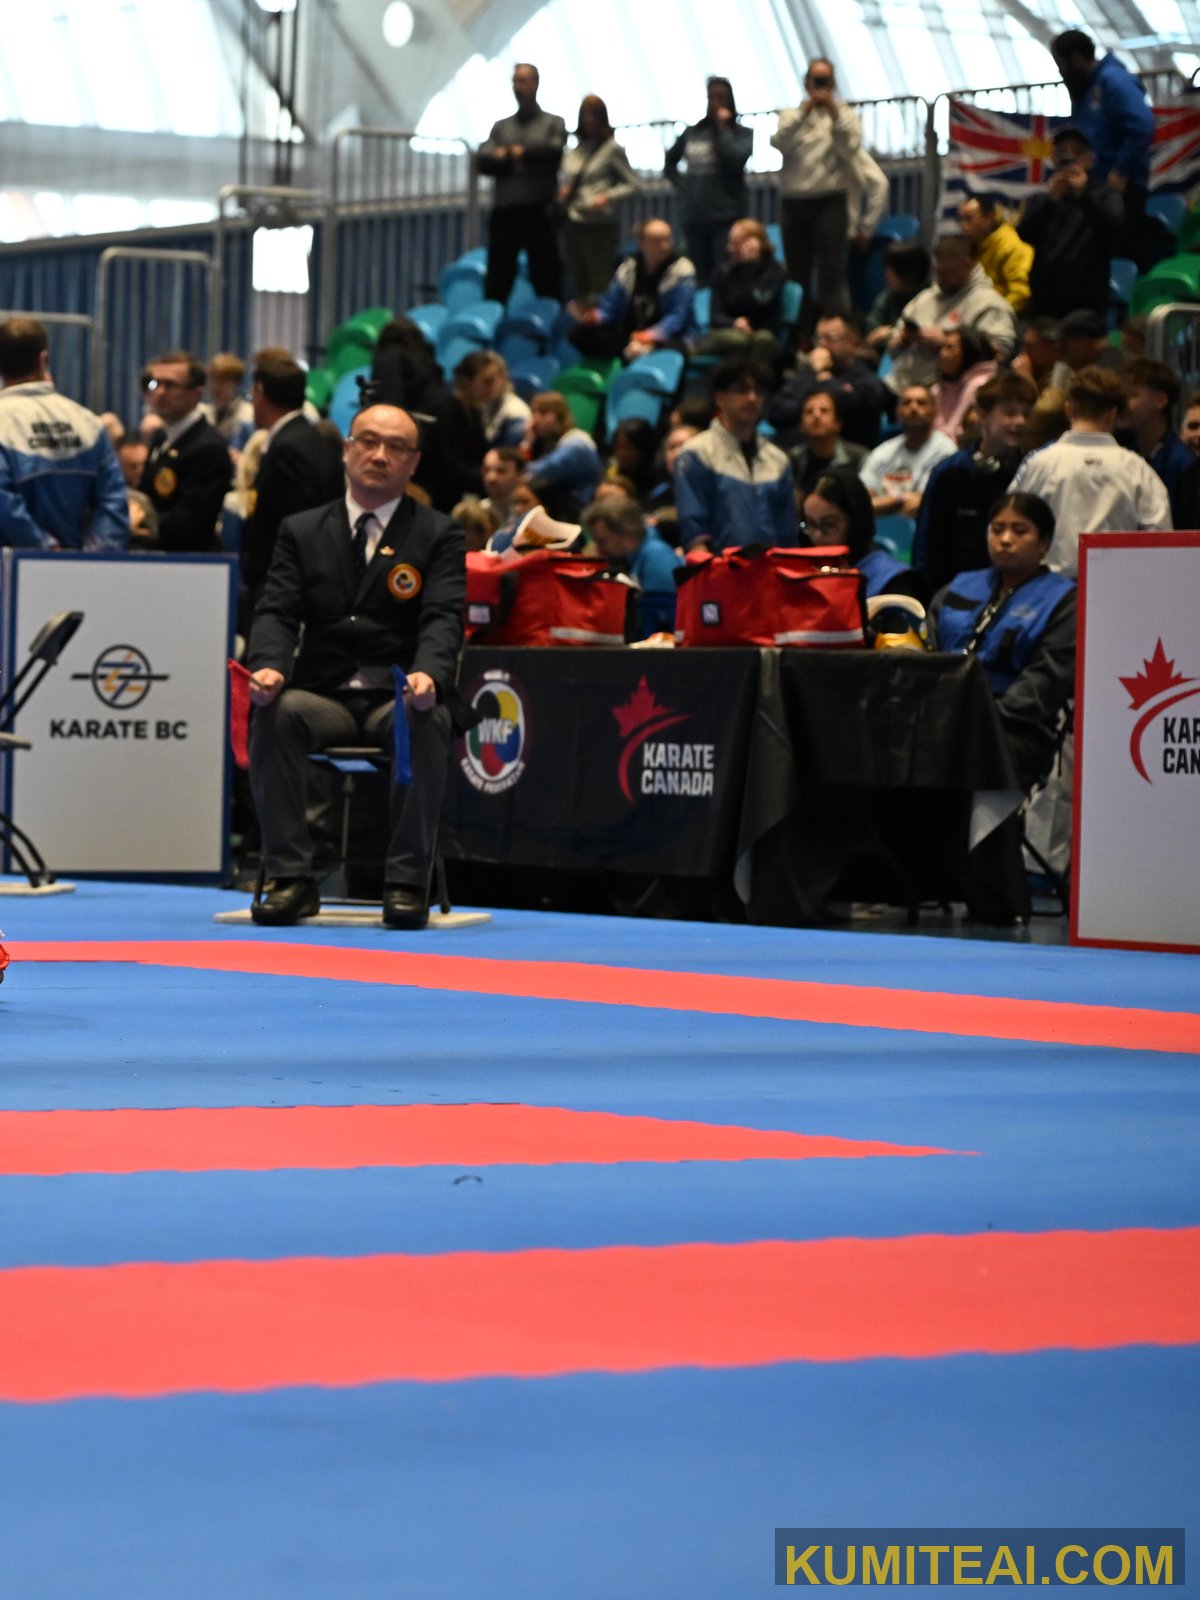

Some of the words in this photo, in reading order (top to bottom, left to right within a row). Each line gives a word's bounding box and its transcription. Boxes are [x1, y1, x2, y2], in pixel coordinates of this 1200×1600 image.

[50, 719, 148, 739] KARATE
[155, 720, 189, 740] BC
[478, 718, 514, 743] WKF
[643, 742, 715, 769] KARATE
[641, 769, 714, 797] CANADA
